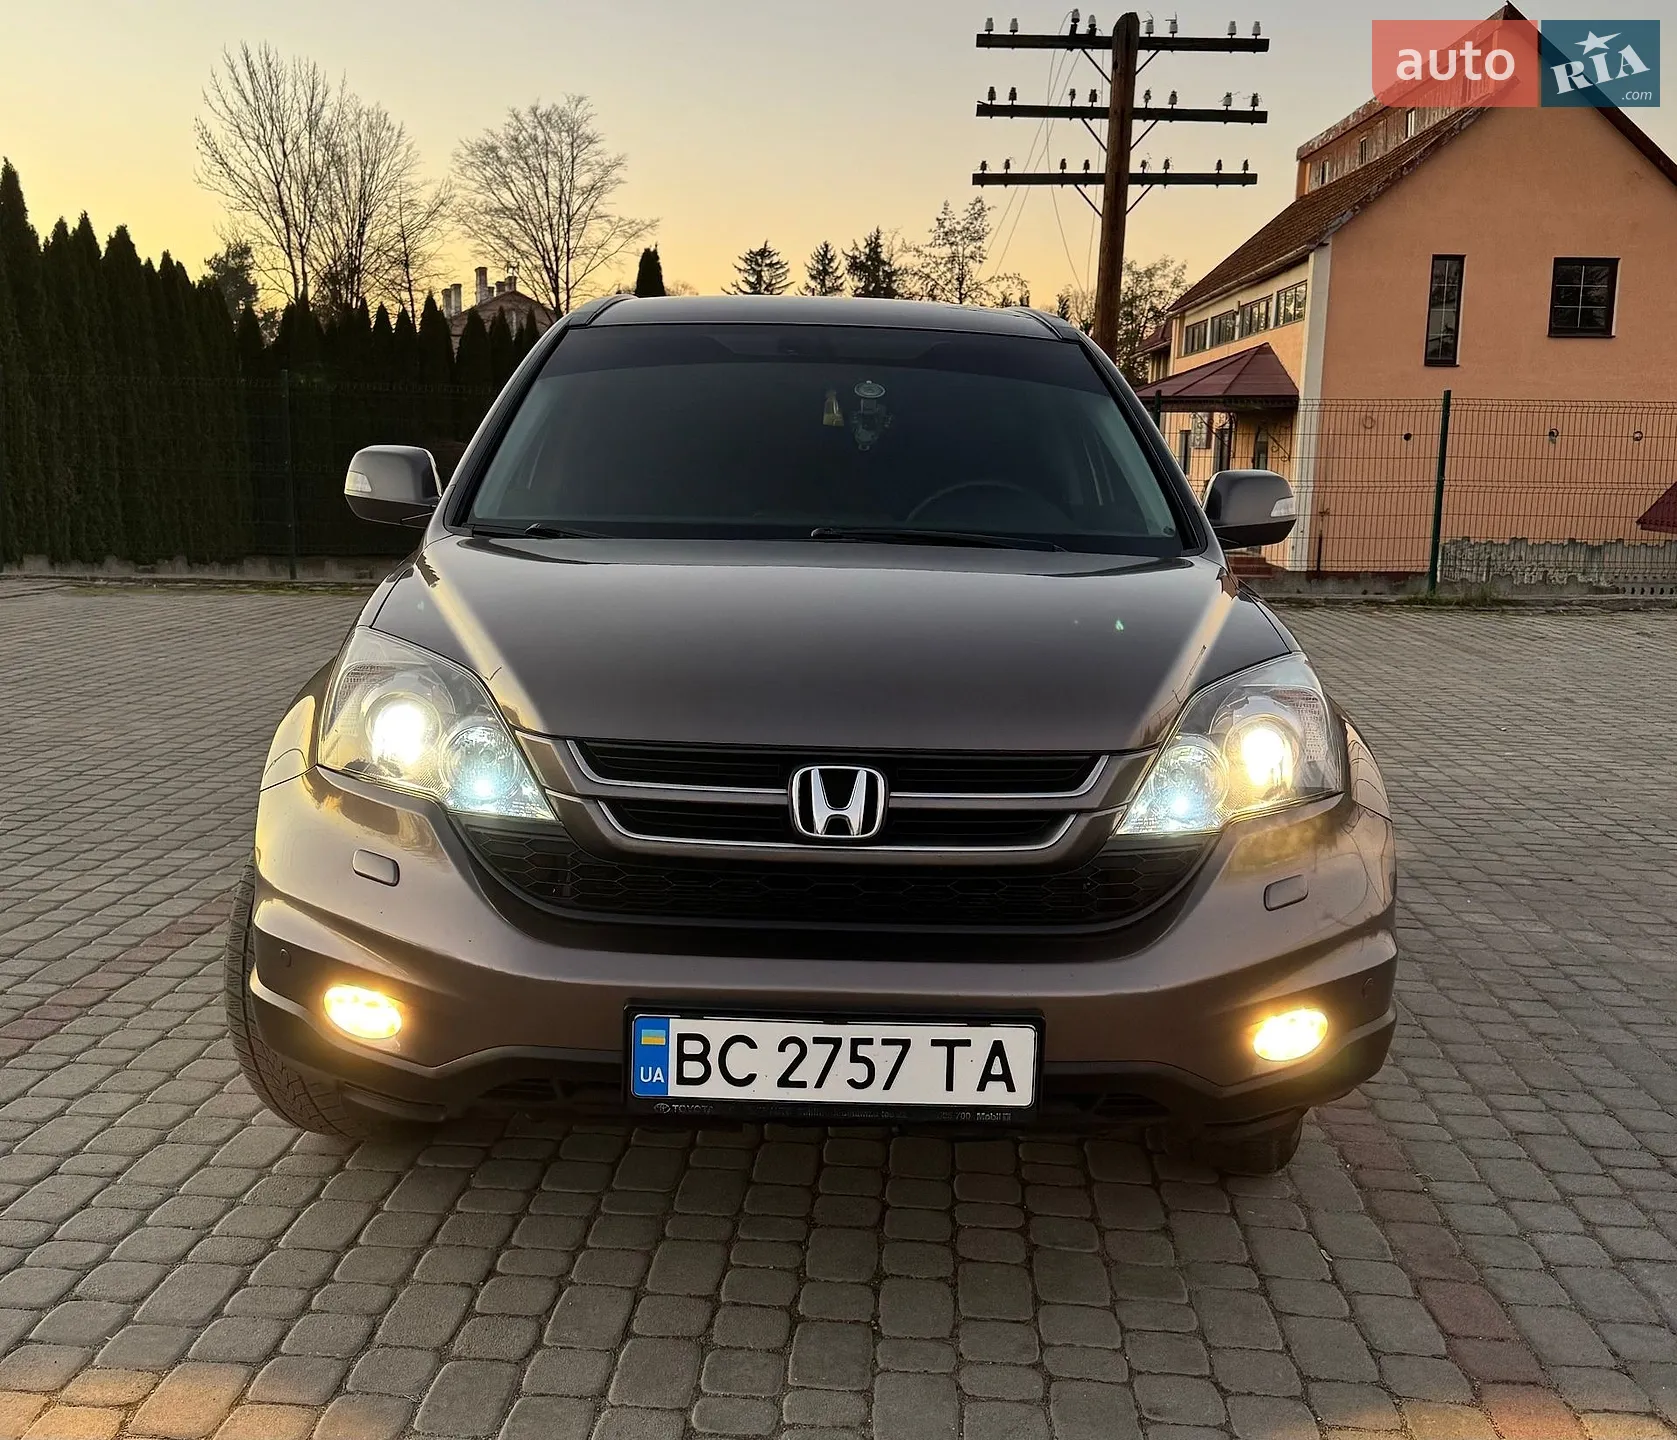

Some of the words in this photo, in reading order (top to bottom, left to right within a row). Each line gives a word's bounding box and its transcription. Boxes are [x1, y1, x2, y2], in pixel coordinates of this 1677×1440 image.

[640, 1067, 666, 1084] UA
[675, 1033, 758, 1088] BC
[776, 1035, 912, 1091] 2757
[930, 1038, 1017, 1093] TA
